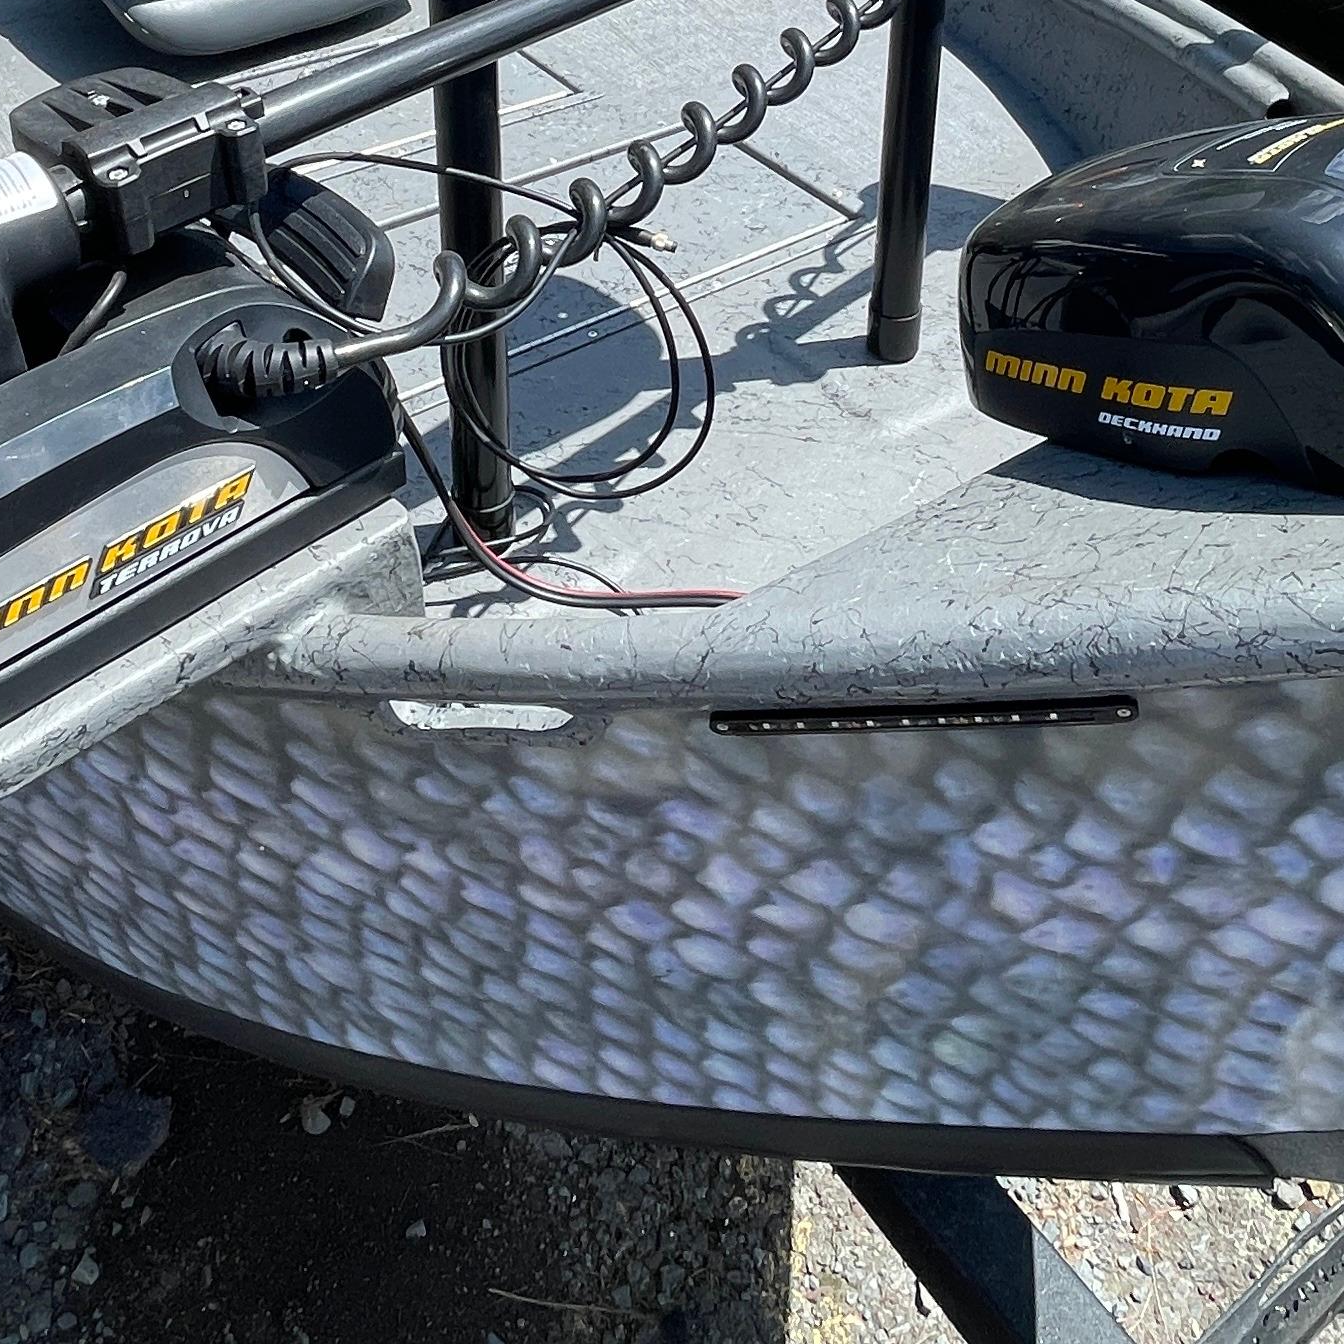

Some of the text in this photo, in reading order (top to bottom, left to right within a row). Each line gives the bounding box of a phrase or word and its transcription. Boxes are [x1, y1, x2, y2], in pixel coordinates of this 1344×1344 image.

[1097, 411, 1223, 442] DECKHAND
[1100, 376, 1234, 416] KOTA
[98, 504, 244, 596] TERROVA
[99, 467, 255, 575] KOTA
